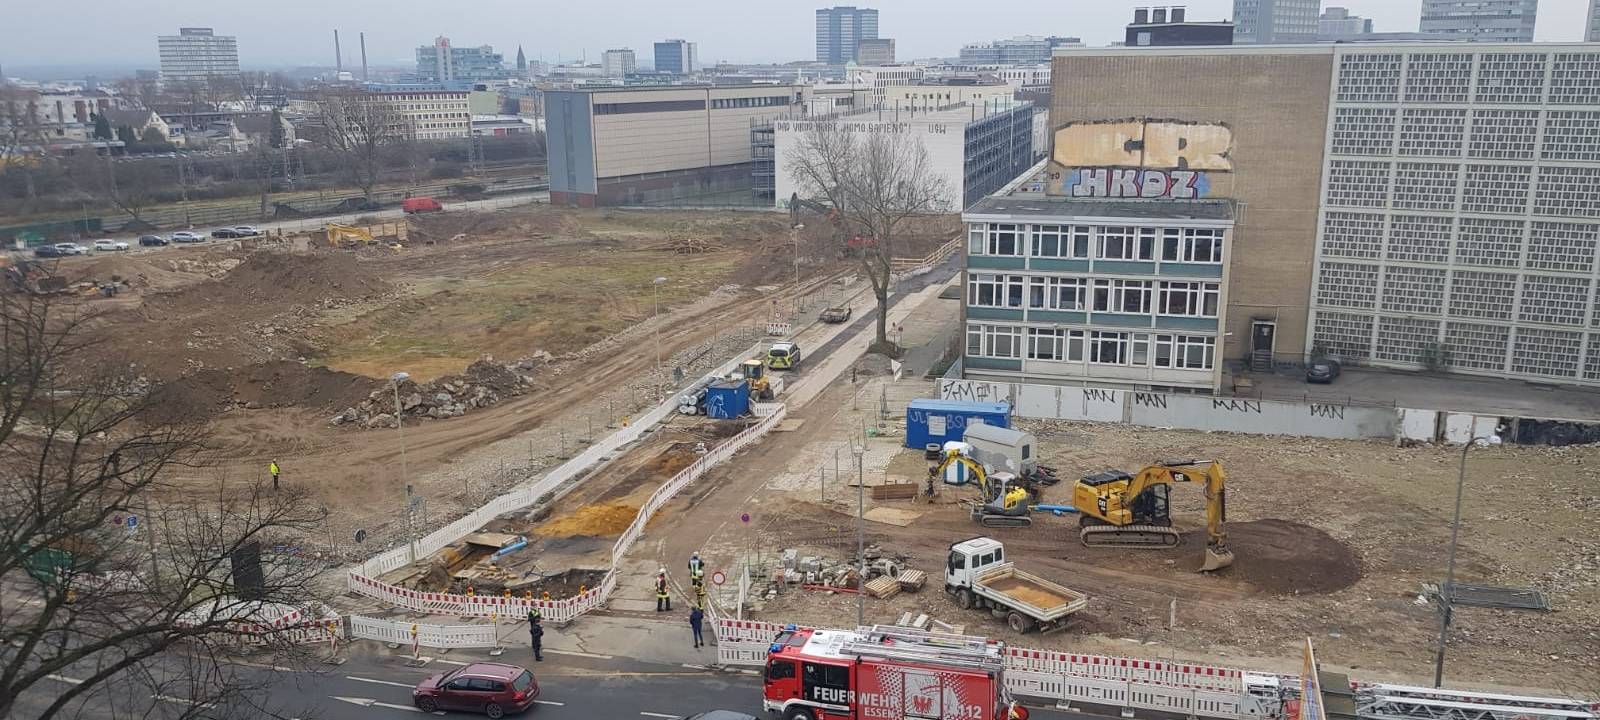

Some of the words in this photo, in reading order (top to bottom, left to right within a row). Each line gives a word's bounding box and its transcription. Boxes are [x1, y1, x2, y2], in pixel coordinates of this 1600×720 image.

[1135, 392, 1167, 409] MAN
[1213, 399, 1261, 413] MAN
[1310, 404, 1345, 419] MAN
[864, 706, 896, 718] ESSEN
[958, 704, 982, 719] 112
